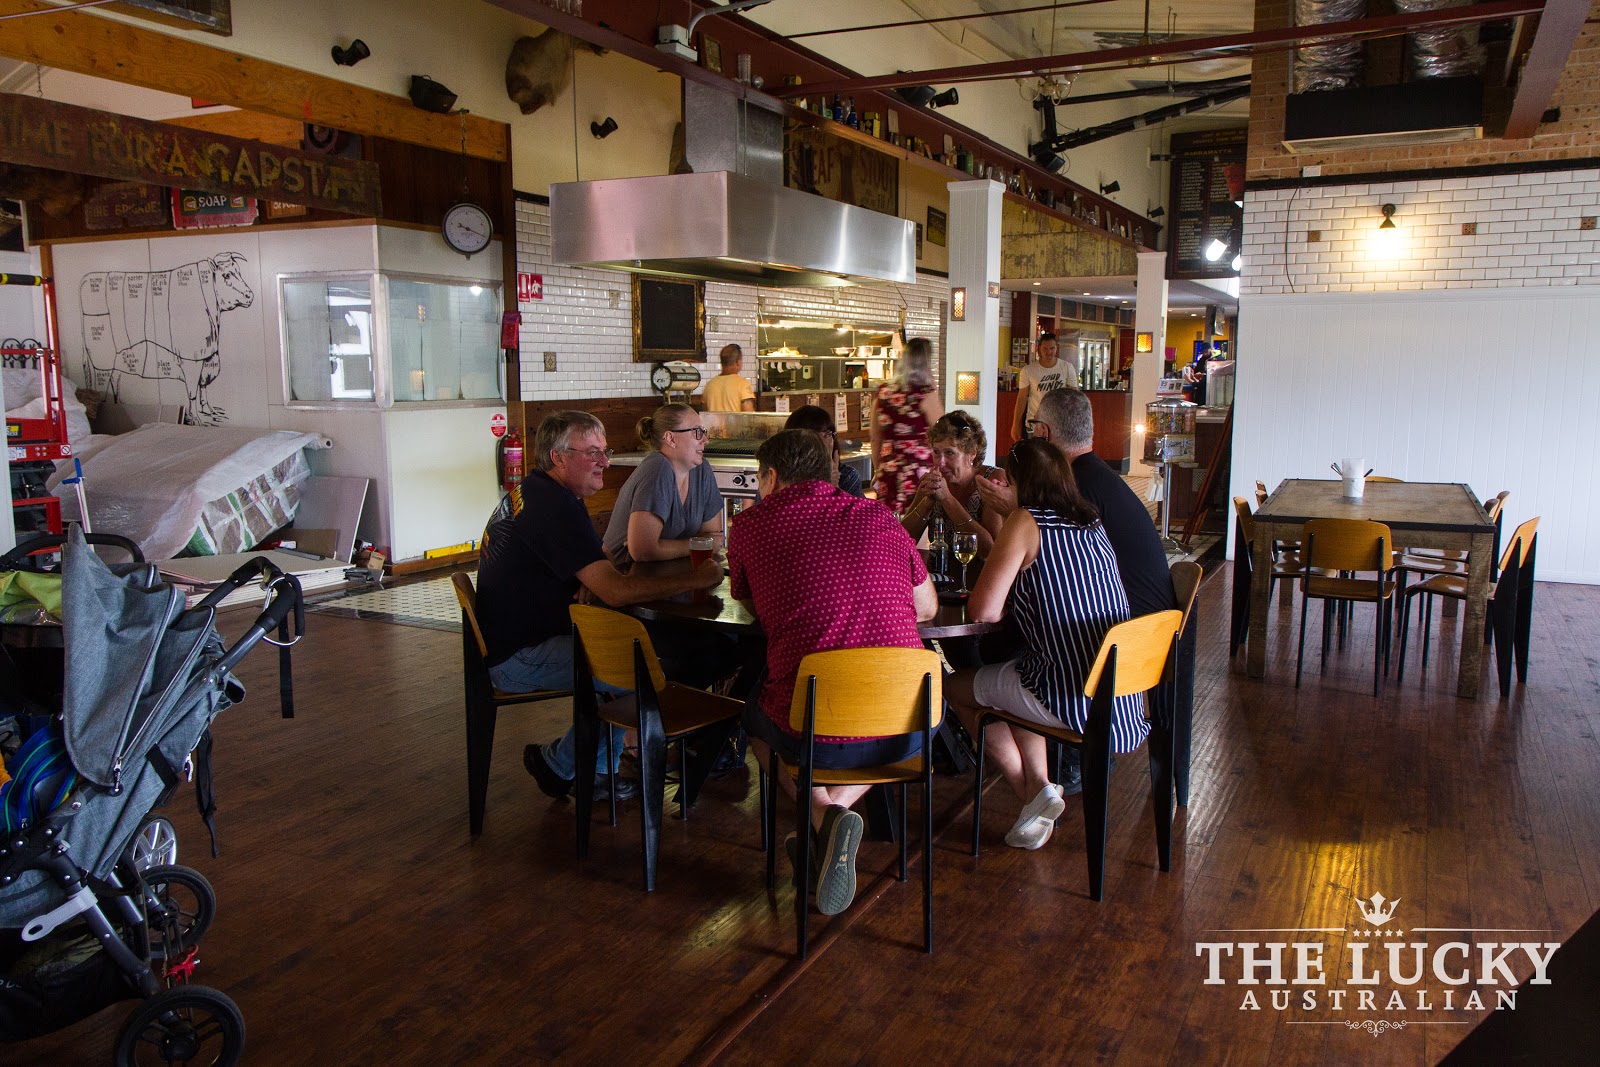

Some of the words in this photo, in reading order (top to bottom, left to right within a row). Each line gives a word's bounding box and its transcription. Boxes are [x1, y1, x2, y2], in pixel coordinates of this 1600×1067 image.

[0, 97, 74, 161] IME
[198, 195, 227, 208] SOAP
[1040, 373, 1061, 383] LOUD
